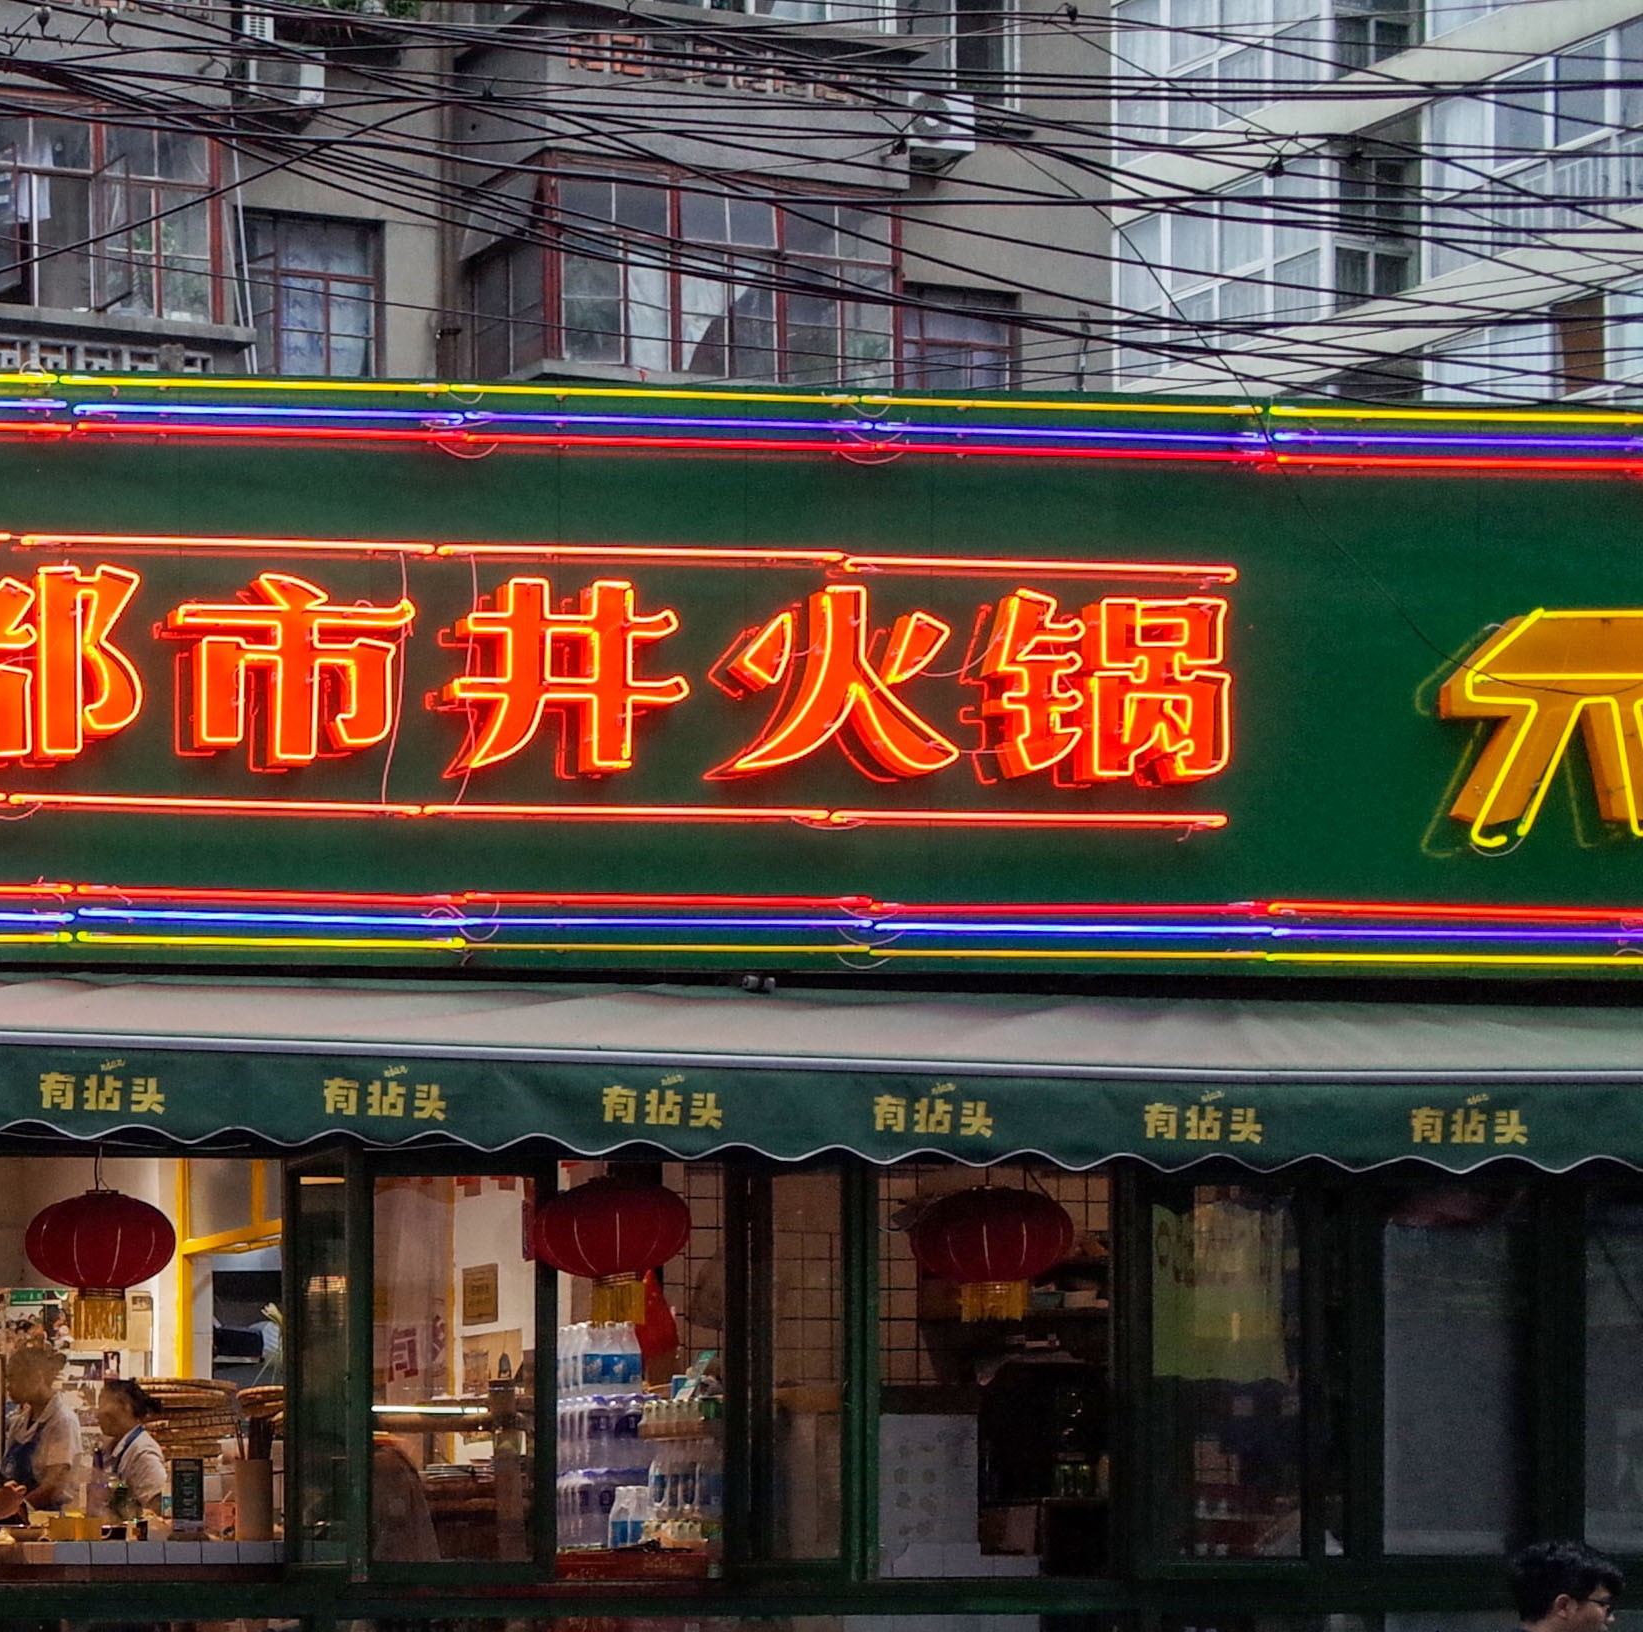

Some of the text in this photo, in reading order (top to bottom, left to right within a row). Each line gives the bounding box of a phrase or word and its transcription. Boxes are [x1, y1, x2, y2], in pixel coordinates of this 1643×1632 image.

[40, 1072, 165, 1112] 有拈头
[324, 1081, 446, 1120] 有拈头
[603, 1087, 722, 1128] 有拈头
[874, 1096, 993, 1136] 有拈头
[1144, 1104, 1262, 1142] 有拈头
[1411, 1108, 1527, 1144] 有拈头
